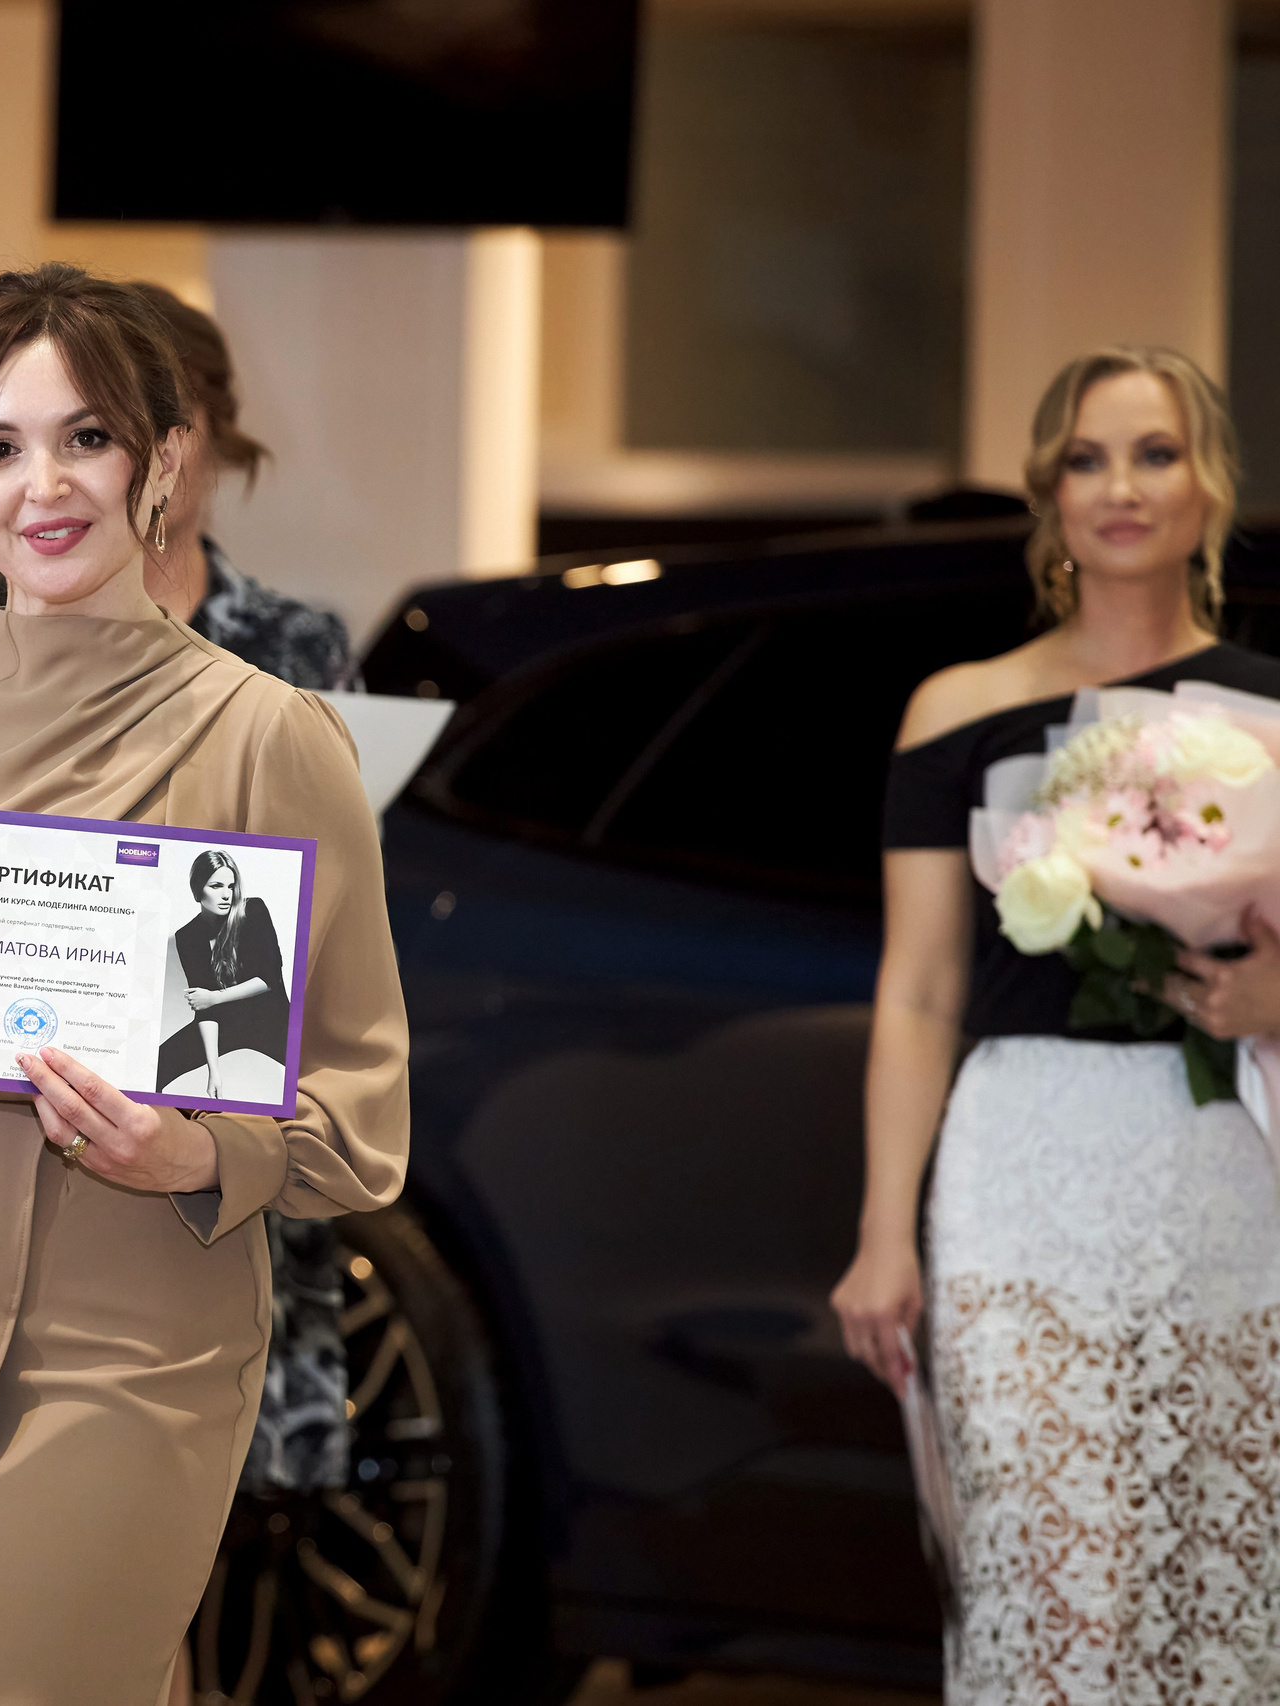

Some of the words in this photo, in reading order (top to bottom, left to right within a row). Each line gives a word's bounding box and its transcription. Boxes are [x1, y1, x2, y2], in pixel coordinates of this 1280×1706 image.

[118, 848, 157, 857] MODELING+
[11, 897, 36, 907] КУРСА
[37, 900, 88, 911] МОДЕЛИНГА
[89, 905, 135, 915] MODELING+
[6, 919, 40, 927] сертификат
[66, 946, 127, 966] ИРИНА
[56, 980, 100, 989] евростандарту
[34, 985, 77, 994] Городчиковой
[90, 1021, 116, 1029] Бушуева
[63, 1043, 81, 1051] Ванда
[82, 1045, 119, 1054] Городчикова
